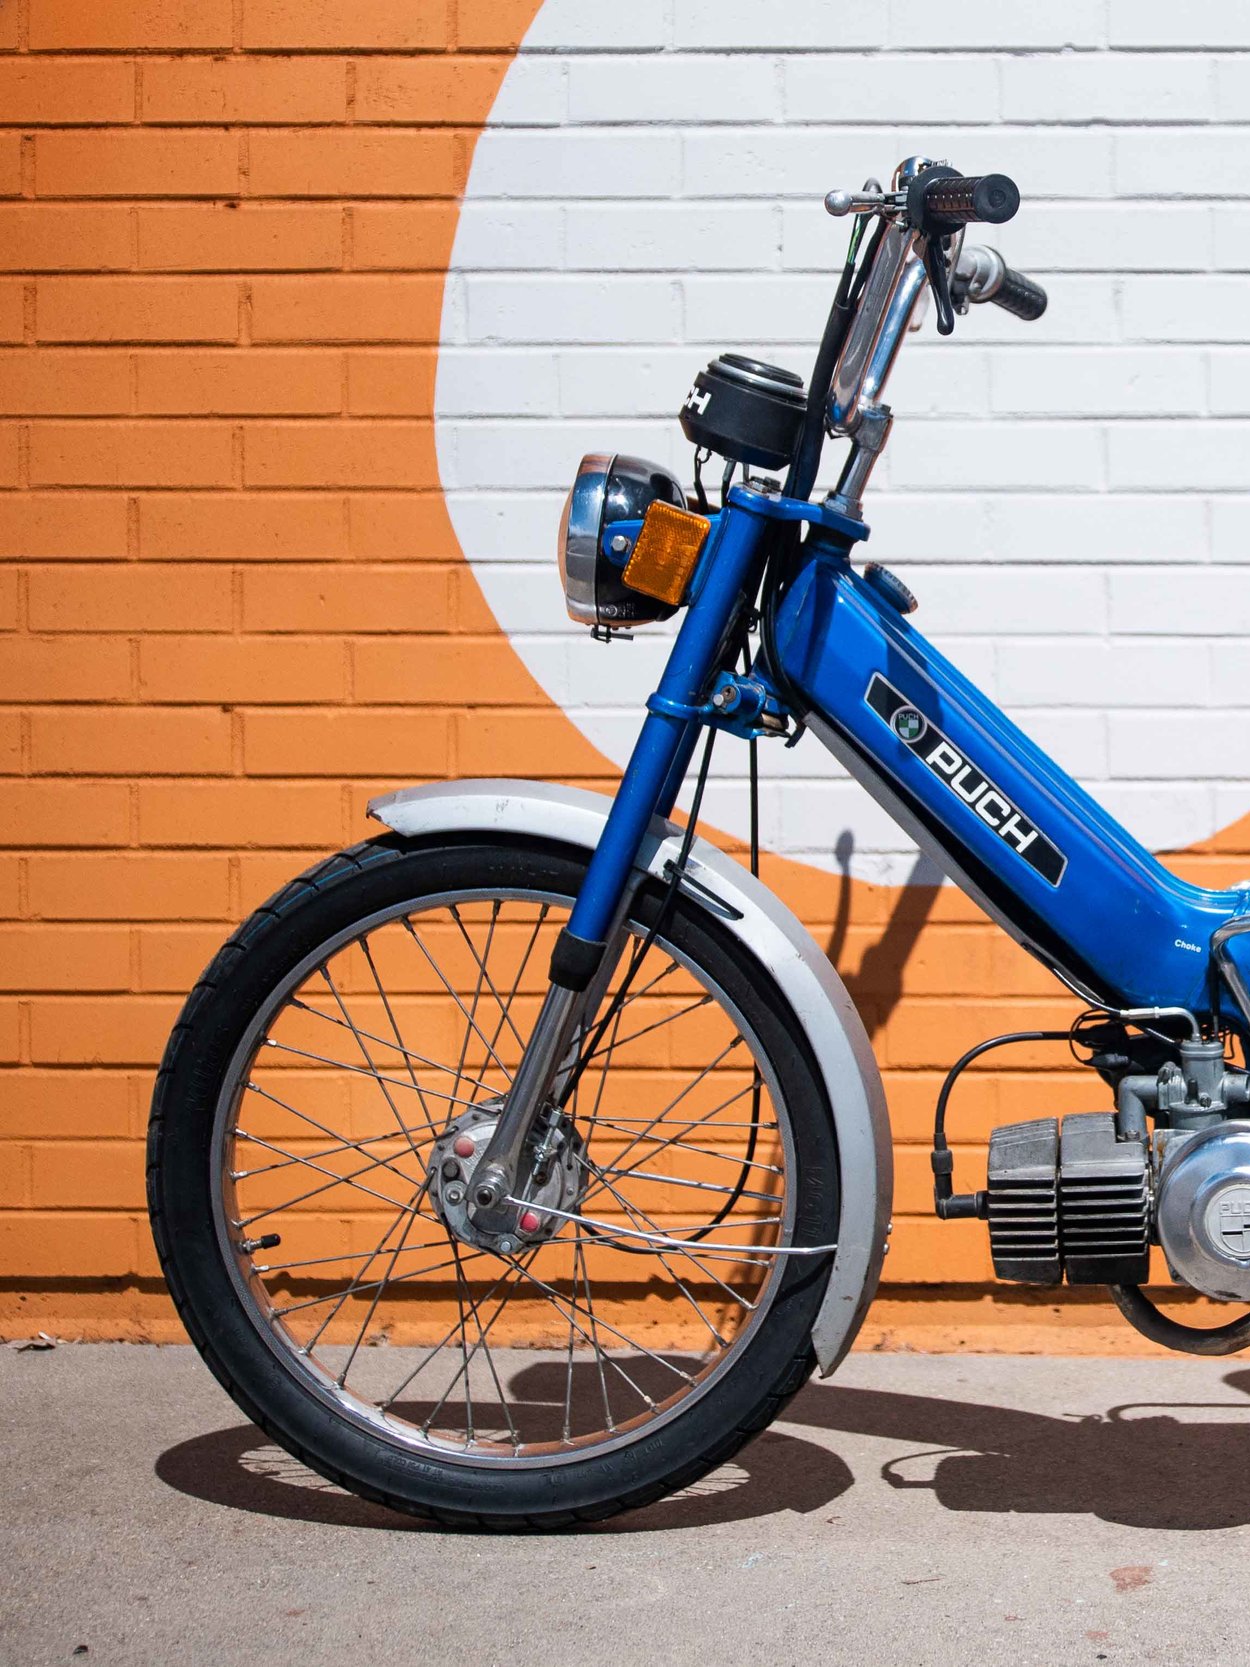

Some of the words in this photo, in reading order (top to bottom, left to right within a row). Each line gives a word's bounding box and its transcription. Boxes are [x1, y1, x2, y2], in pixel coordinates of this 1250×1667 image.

[687, 387, 712, 415] H
[925, 741, 1039, 854] PUCH
[1174, 939, 1202, 953] Choke
